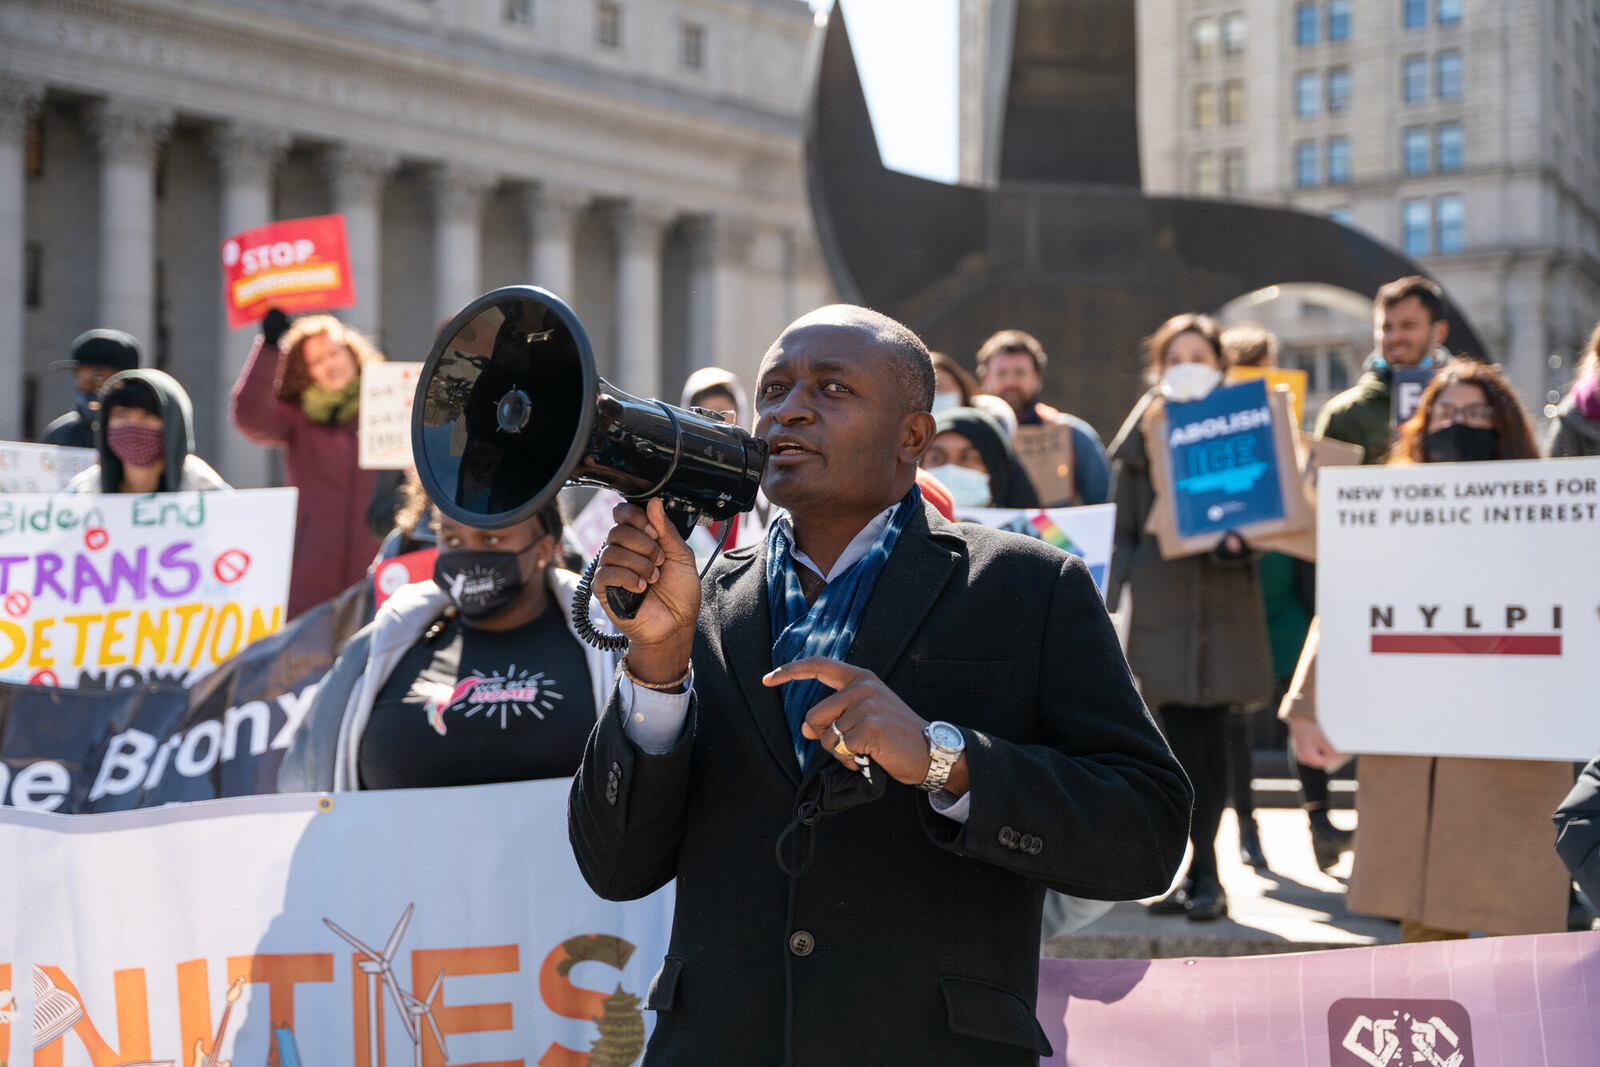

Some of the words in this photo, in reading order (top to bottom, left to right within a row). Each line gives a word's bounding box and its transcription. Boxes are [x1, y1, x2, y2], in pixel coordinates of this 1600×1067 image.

[241, 239, 315, 275] STOP
[1169, 407, 1271, 448] ABOLISH
[1187, 434, 1258, 479] ICE
[1338, 484, 1383, 502] NEW
[1392, 482, 1446, 501] YORK
[1454, 479, 1547, 498] LAWYERS
[1556, 478, 1597, 496] FOR
[0, 497, 105, 536] Biden
[132, 491, 205, 527] End
[1338, 509, 1377, 527] THE
[1390, 506, 1473, 525] PUBLIC
[1484, 503, 1597, 523] INTEREST
[0, 543, 201, 604] TRANS
[0, 602, 281, 669] DETENTION
[1370, 604, 1563, 629] NYLPI
[468, 687, 538, 703] HOME
[89, 683, 320, 802] Bronx
